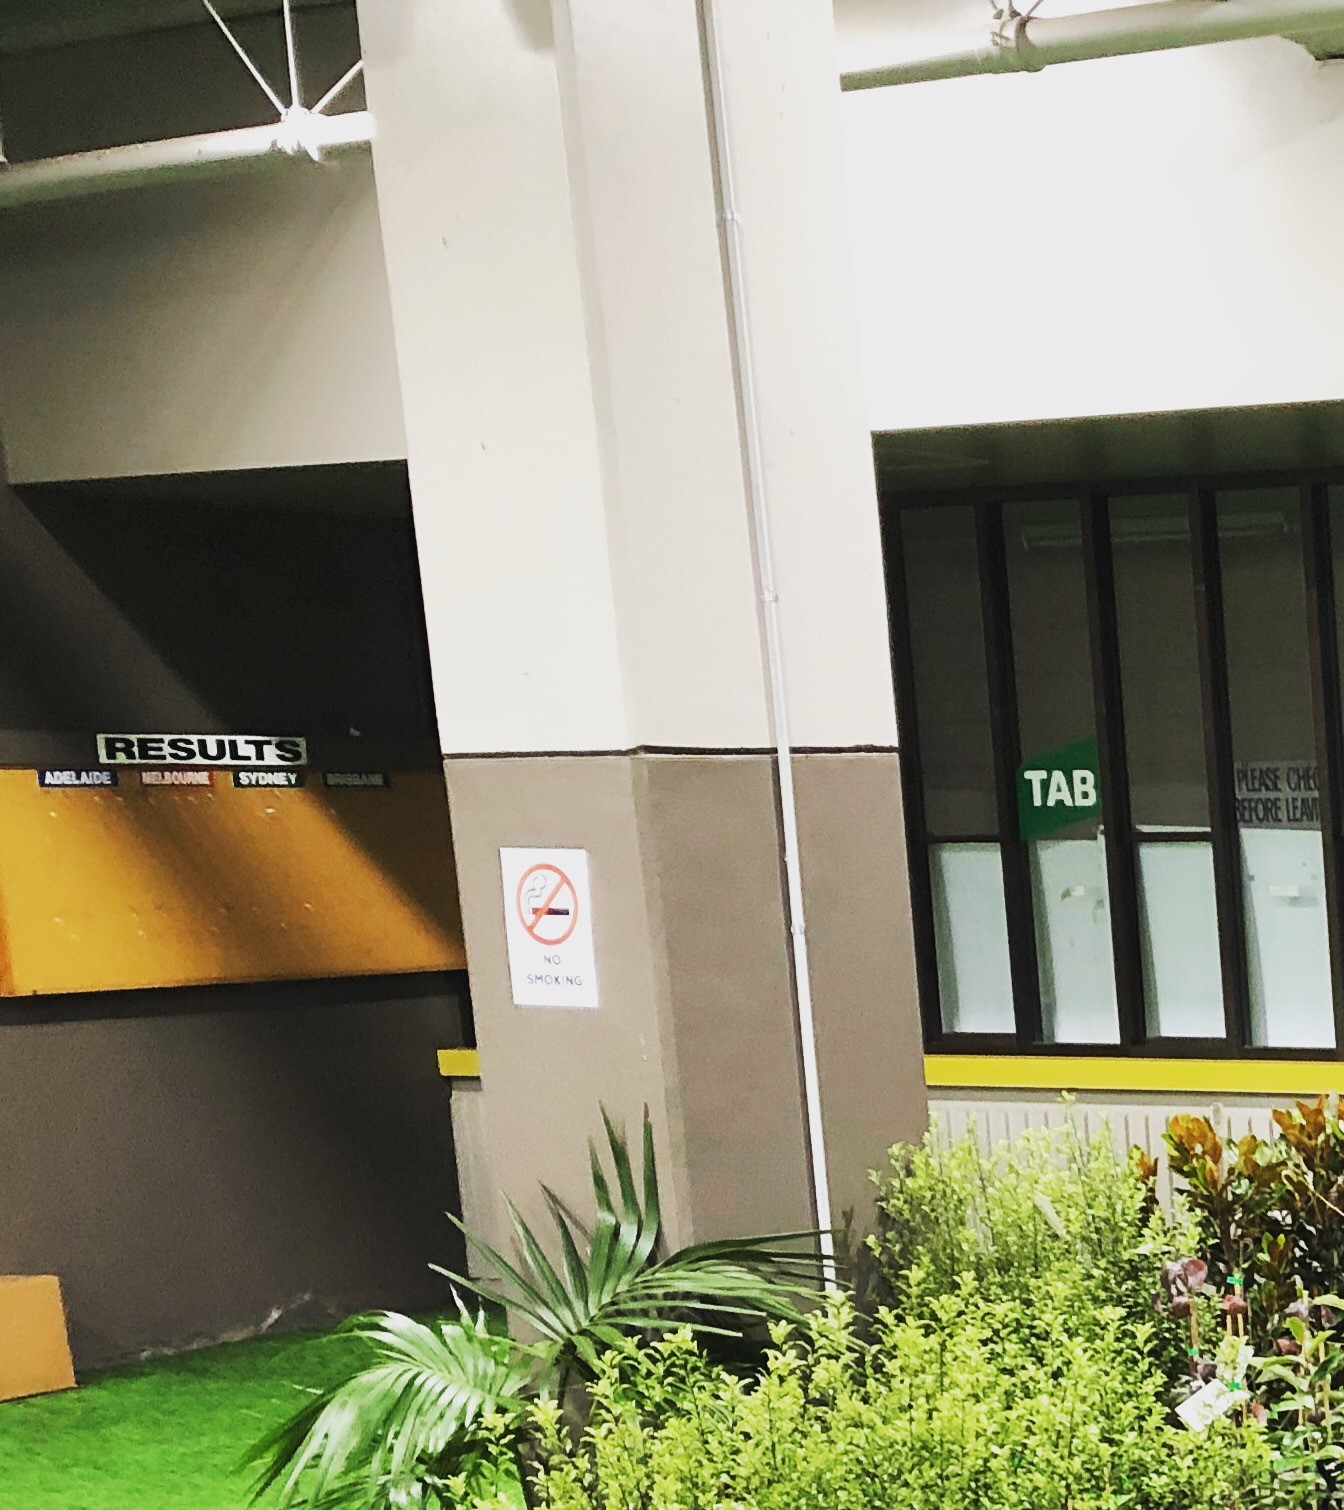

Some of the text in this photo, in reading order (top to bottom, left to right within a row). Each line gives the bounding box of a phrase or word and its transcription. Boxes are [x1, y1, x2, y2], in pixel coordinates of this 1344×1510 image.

[104, 737, 305, 763] RESULTS
[44, 771, 112, 785] ADELAIDE
[142, 771, 209, 786] MELBOURNE
[238, 771, 298, 786] SYDNEY
[1236, 766, 1282, 792] PLEASE
[1286, 766, 1320, 792] CHEC
[1023, 769, 1097, 807] TAB
[1236, 797, 1283, 823] BEFORE
[1285, 797, 1321, 822] LEAVI
[543, 954, 562, 966] NO
[526, 973, 583, 987] SMOKING
